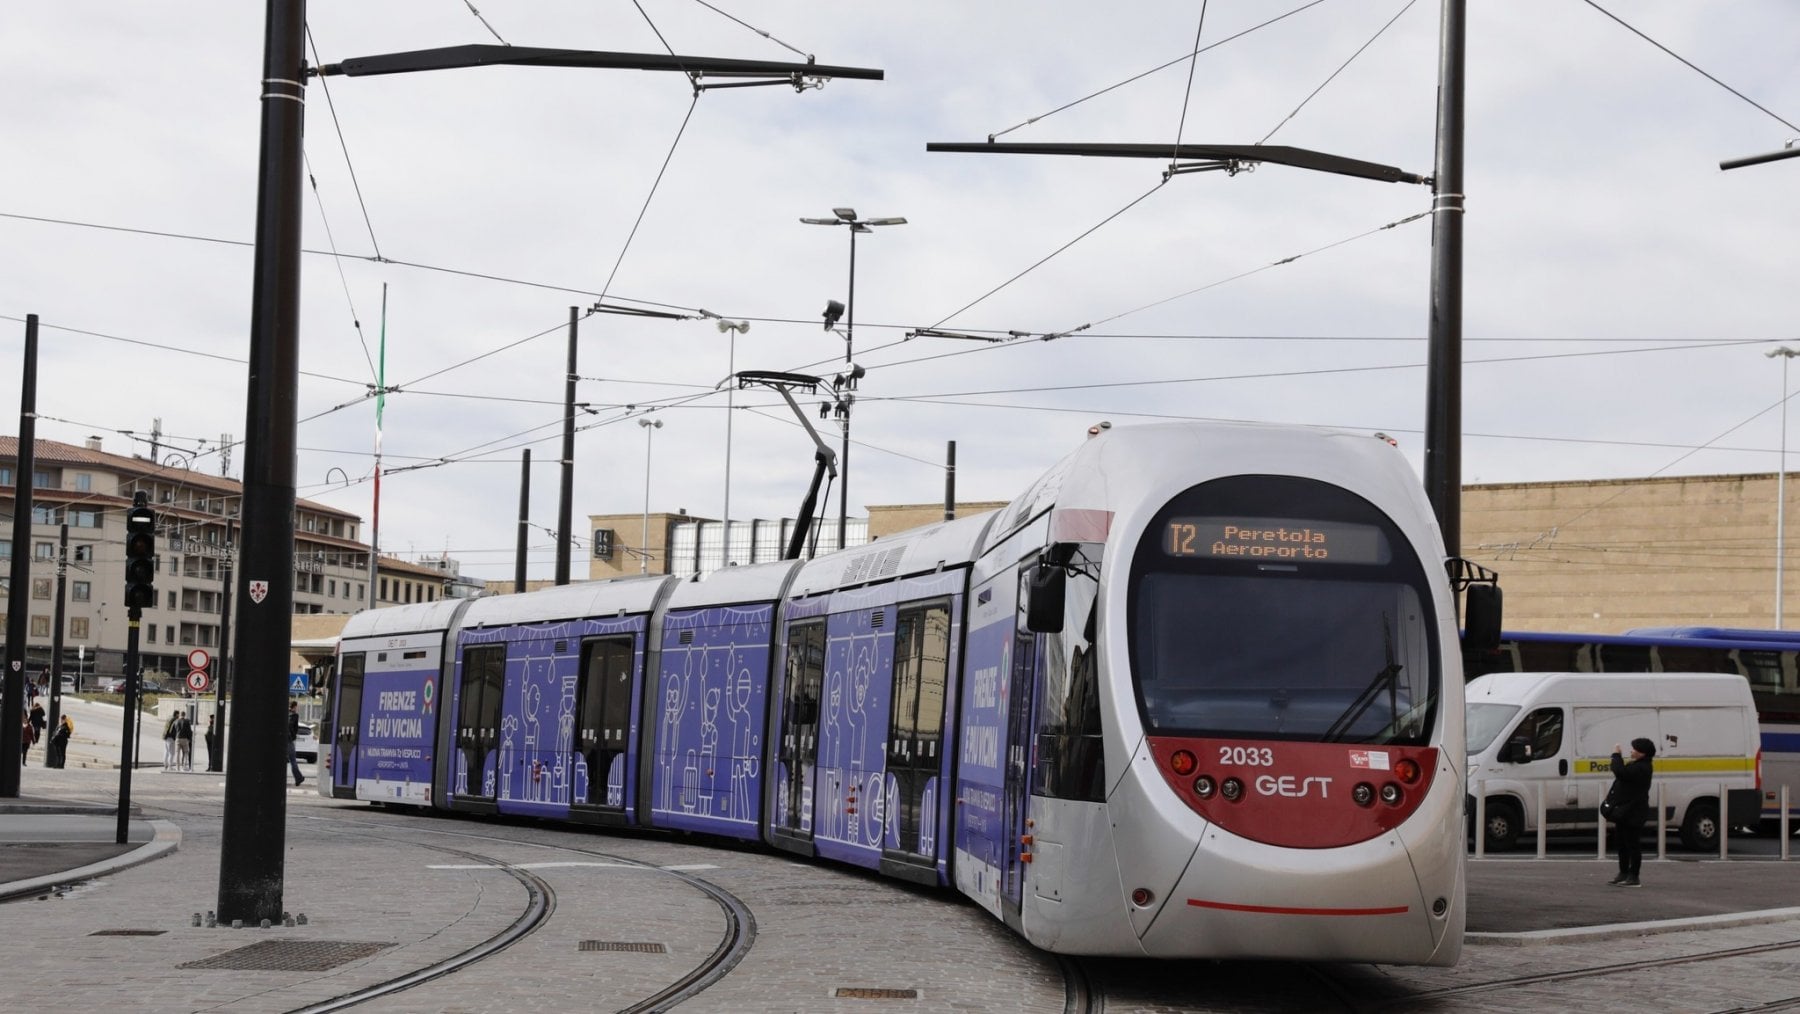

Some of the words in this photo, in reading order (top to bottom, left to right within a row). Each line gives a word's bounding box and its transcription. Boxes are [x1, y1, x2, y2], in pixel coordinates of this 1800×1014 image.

[1170, 523, 1196, 554] T2
[1224, 525, 1325, 543] Peretola
[1212, 541, 1328, 559] Aeroporto
[973, 666, 997, 708] FIRENZE
[379, 691, 416, 711] FIRENZE
[369, 713, 375, 738] È
[375, 713, 392, 739] PIÙ
[392, 718, 422, 739] VICINA
[979, 725, 998, 768] VICINA
[1219, 746, 1274, 767] 2033
[1590, 761, 1610, 772] Pos
[1255, 775, 1333, 799] GEST
